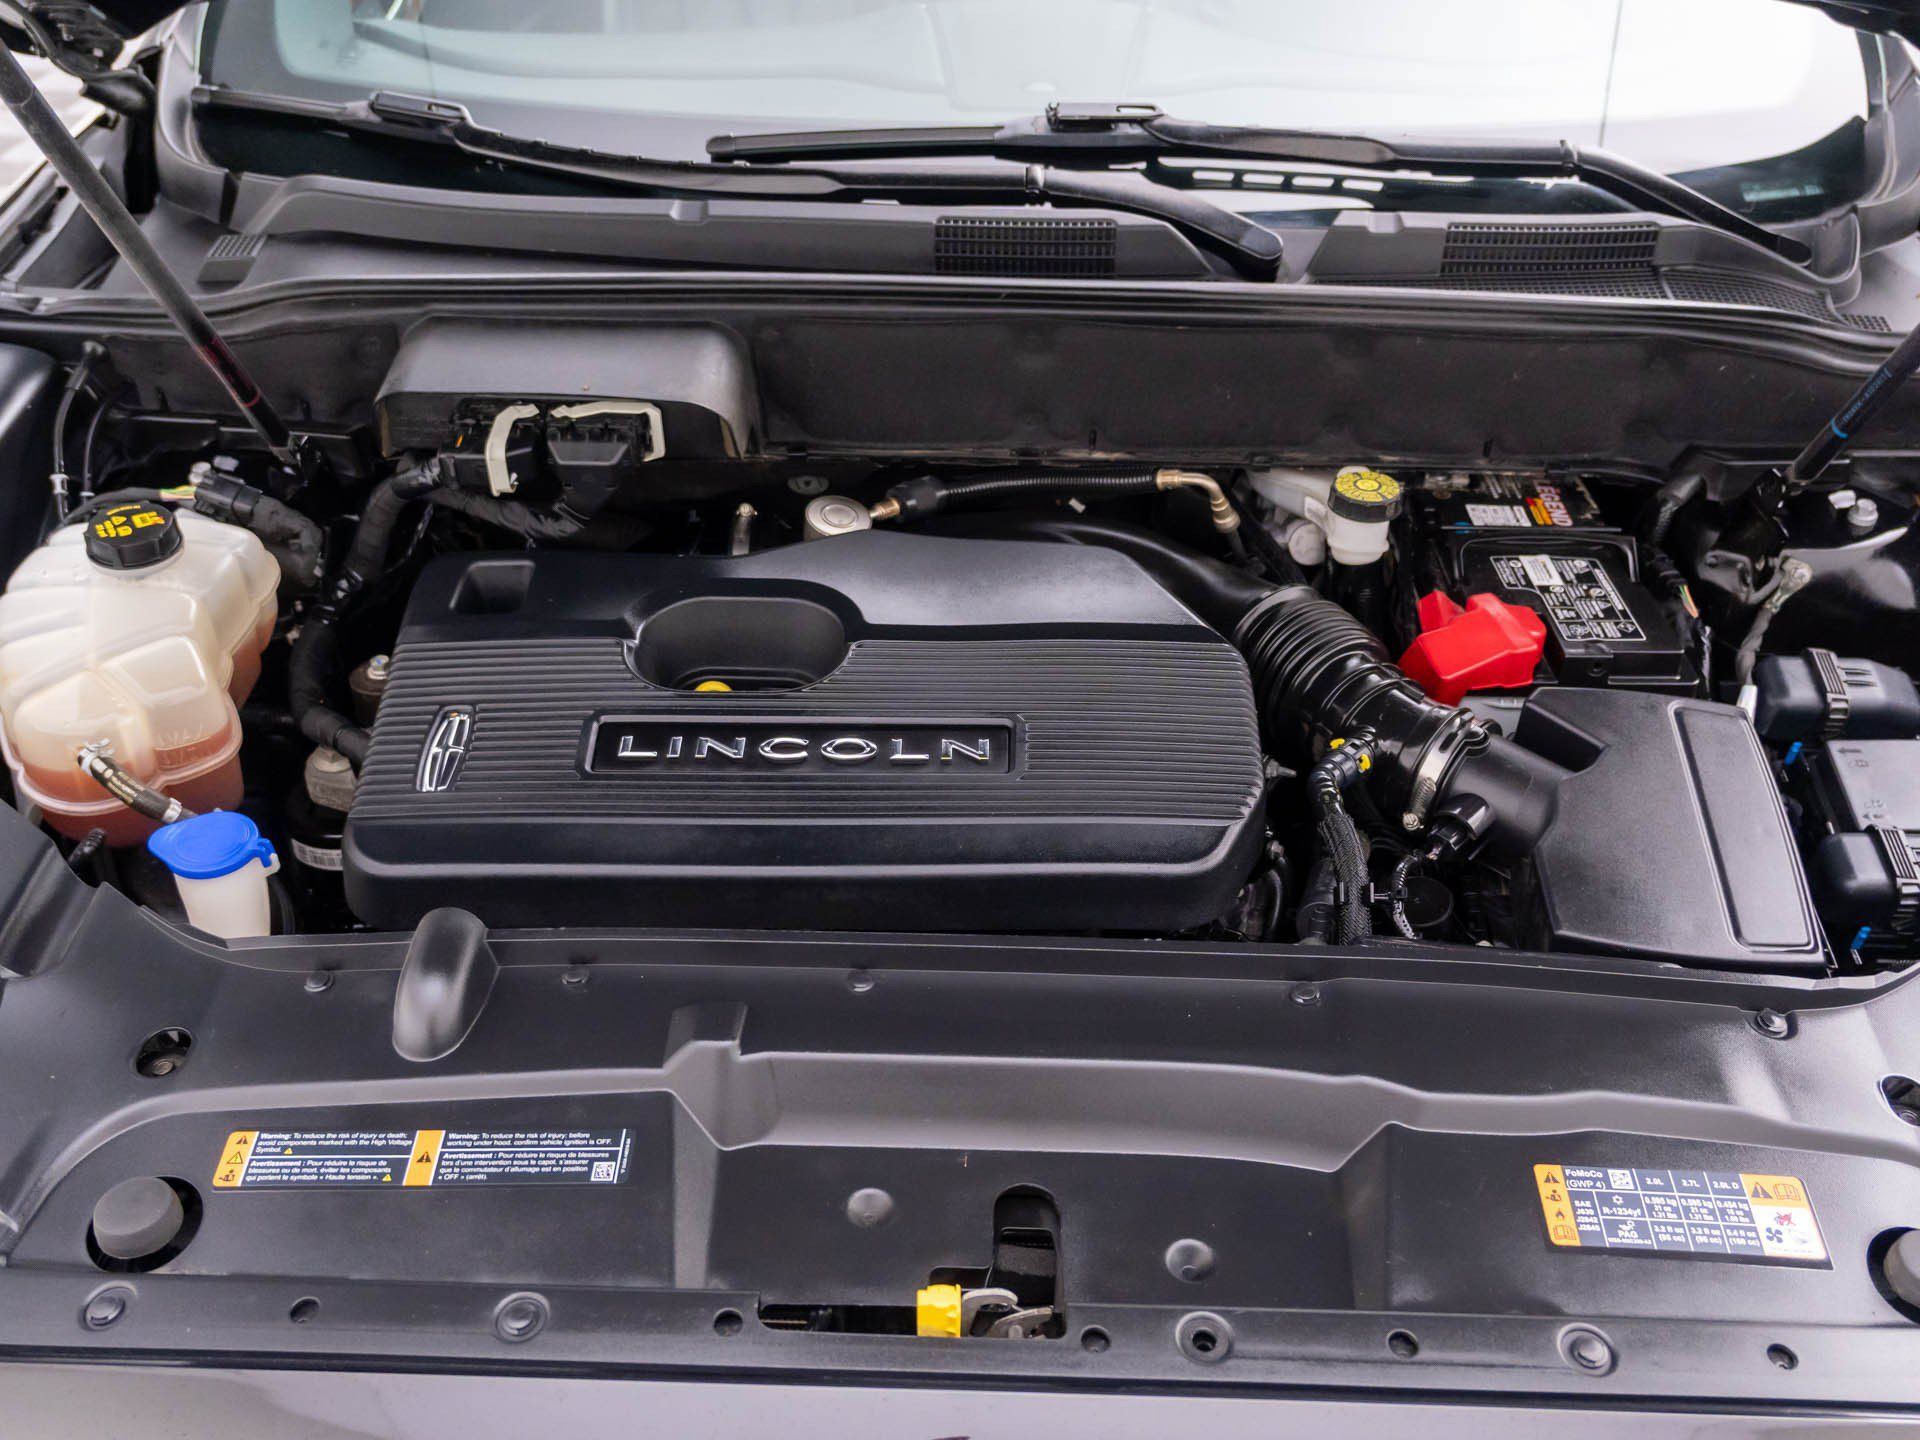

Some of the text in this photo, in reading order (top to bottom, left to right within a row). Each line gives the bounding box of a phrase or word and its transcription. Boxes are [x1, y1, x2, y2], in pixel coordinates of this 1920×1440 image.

[1533, 480, 1573, 527] LEGEND
[617, 735, 991, 760] LINCOLN
[1564, 1168, 1604, 1178] FoMoCo
[1566, 1179, 1606, 1190] (GWP 4)
[1602, 1206, 1642, 1217] R-1234yf
